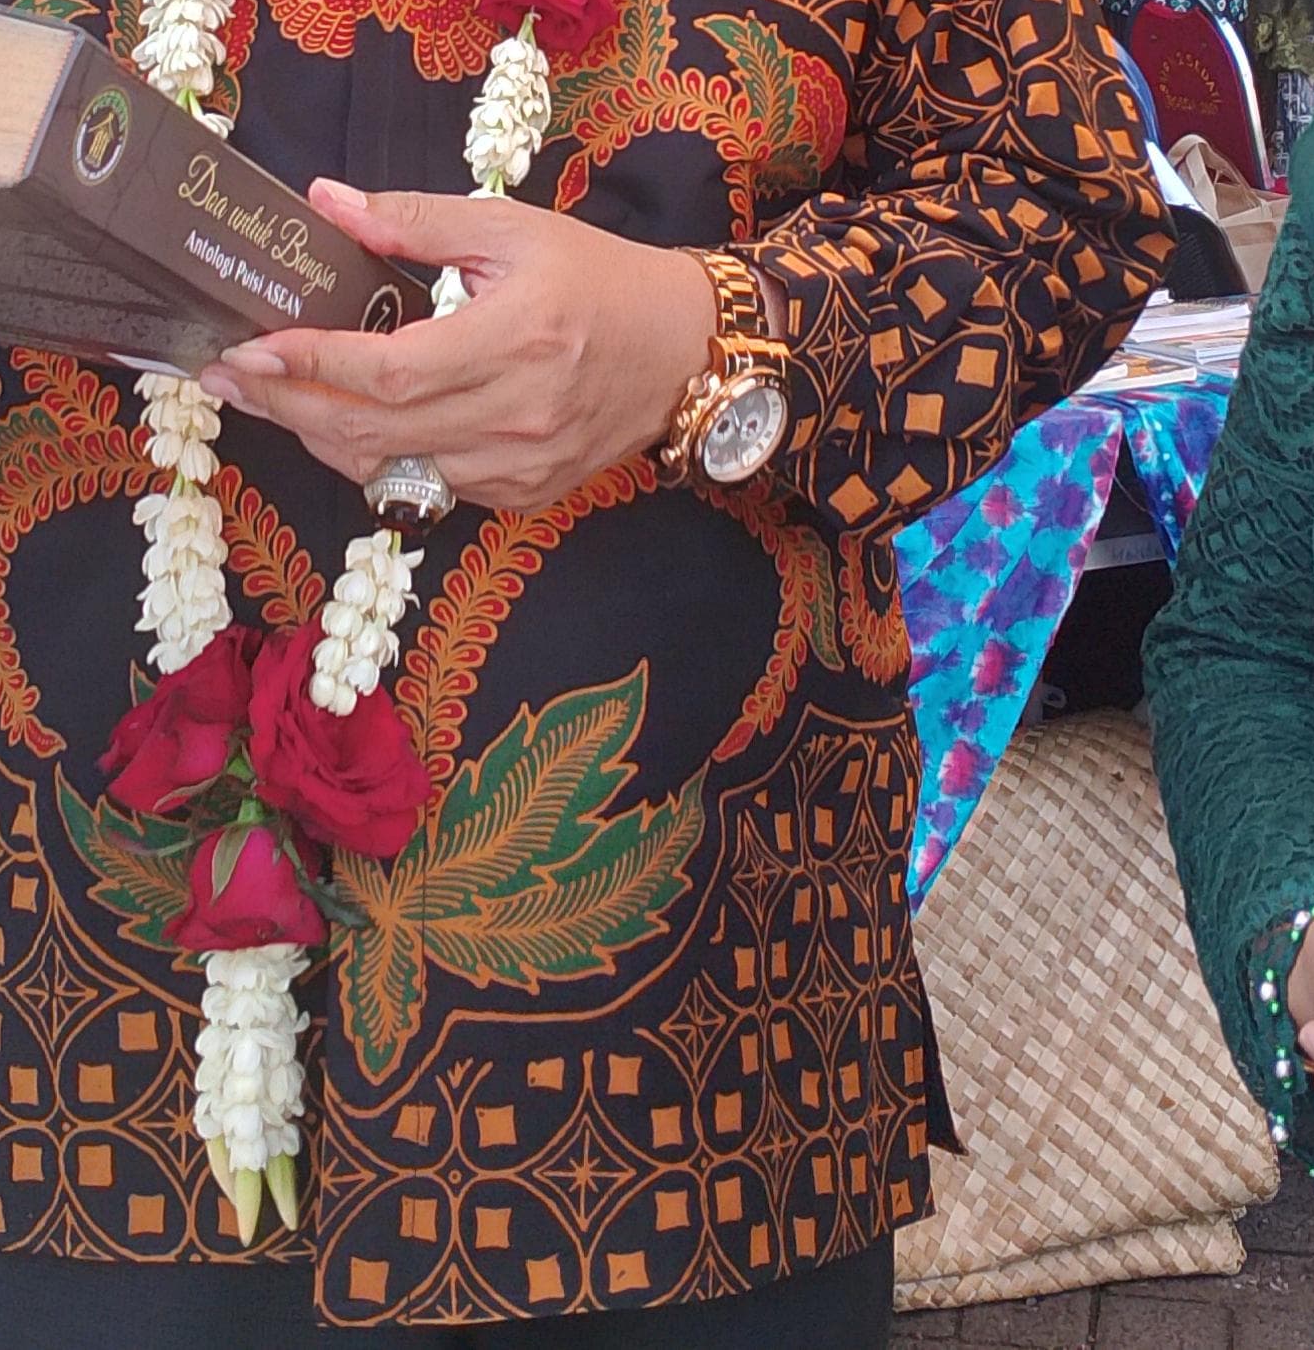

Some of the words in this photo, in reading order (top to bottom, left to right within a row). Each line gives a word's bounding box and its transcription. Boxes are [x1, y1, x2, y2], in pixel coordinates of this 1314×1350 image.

[183, 228, 236, 280] Antologi
[234, 258, 265, 295] Puisi
[262, 279, 304, 321] ASEAN
[227, 205, 279, 250] untuk
[270, 217, 339, 298] Bangsa
